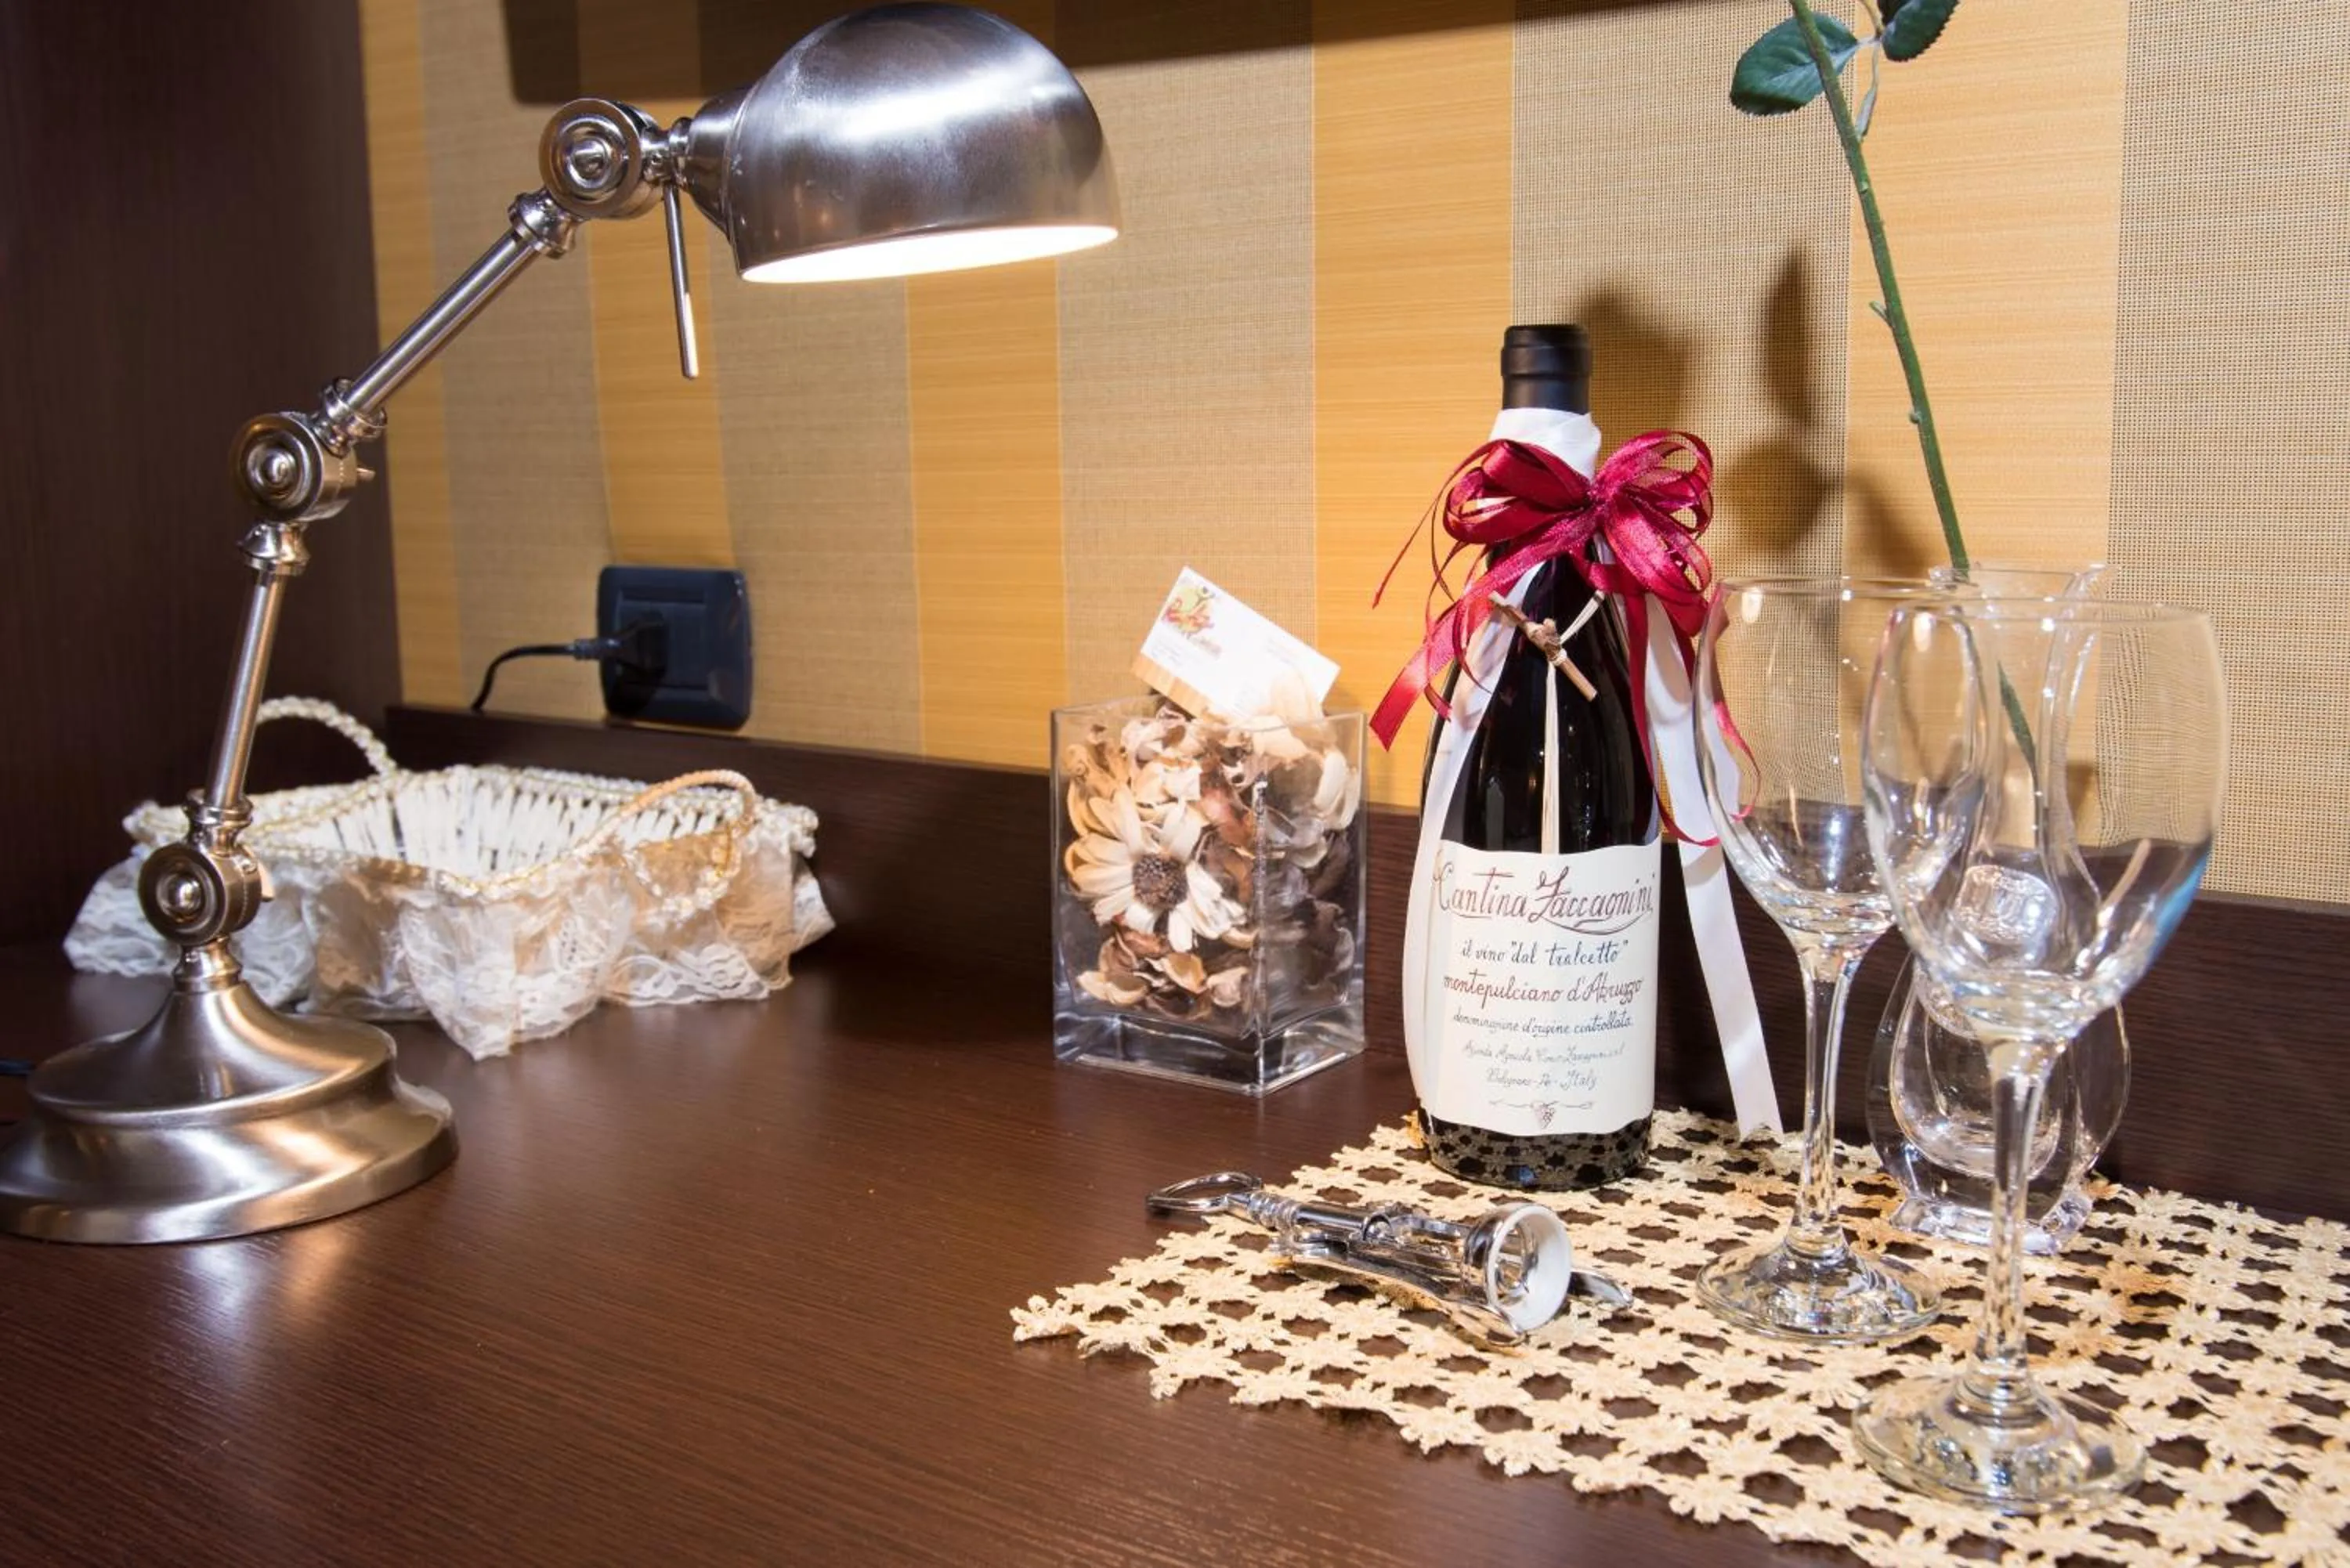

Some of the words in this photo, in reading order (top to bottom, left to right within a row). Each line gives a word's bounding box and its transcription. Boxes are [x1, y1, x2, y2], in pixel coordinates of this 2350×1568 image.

[1434, 862, 1528, 919] Cantina
[1528, 865, 1656, 934] Zaccagnini
[1462, 940, 1473, 957] il
[1476, 946, 1506, 962] vino
[1444, 969, 1565, 1010] montepulciano
